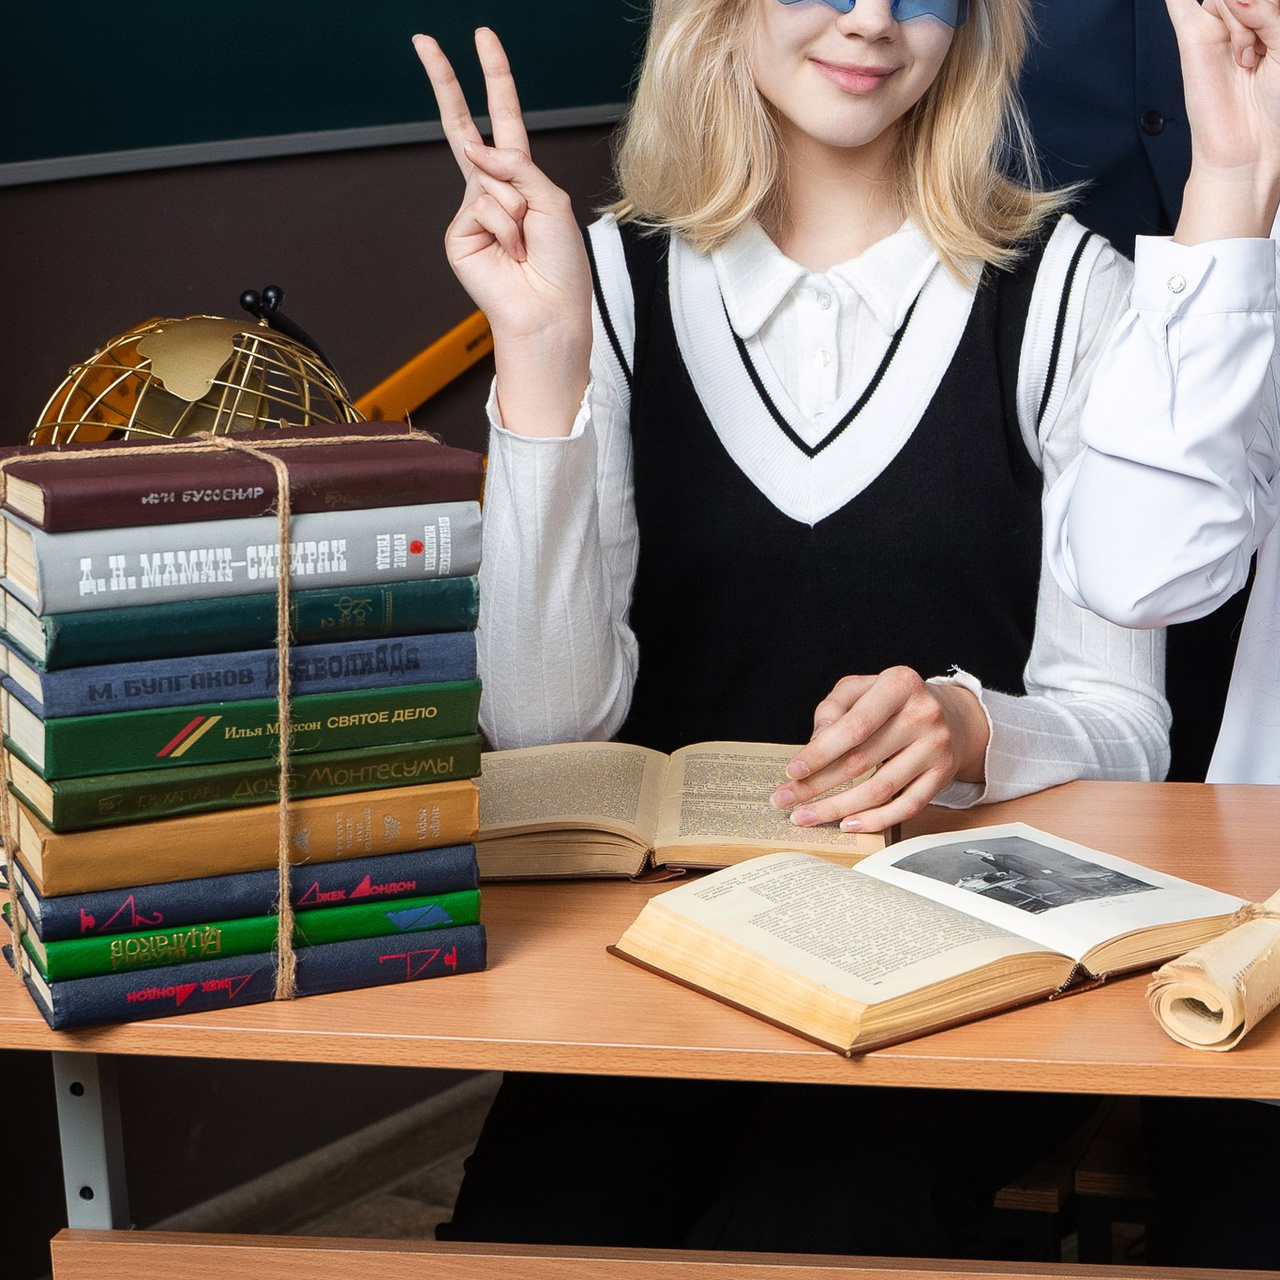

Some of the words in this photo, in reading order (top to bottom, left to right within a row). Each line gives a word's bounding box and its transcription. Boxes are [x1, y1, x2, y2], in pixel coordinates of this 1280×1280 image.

[182, 486, 265, 503] БУССЕНАР
[140, 539, 347, 589] МАМИН-СИИРЯК
[88, 683, 118, 701] М.
[124, 668, 256, 699] БУЛГАКОВ
[224, 726, 263, 740] Илья
[327, 712, 388, 730] СВЯТОЕ
[391, 706, 438, 724] ДЕЛО
